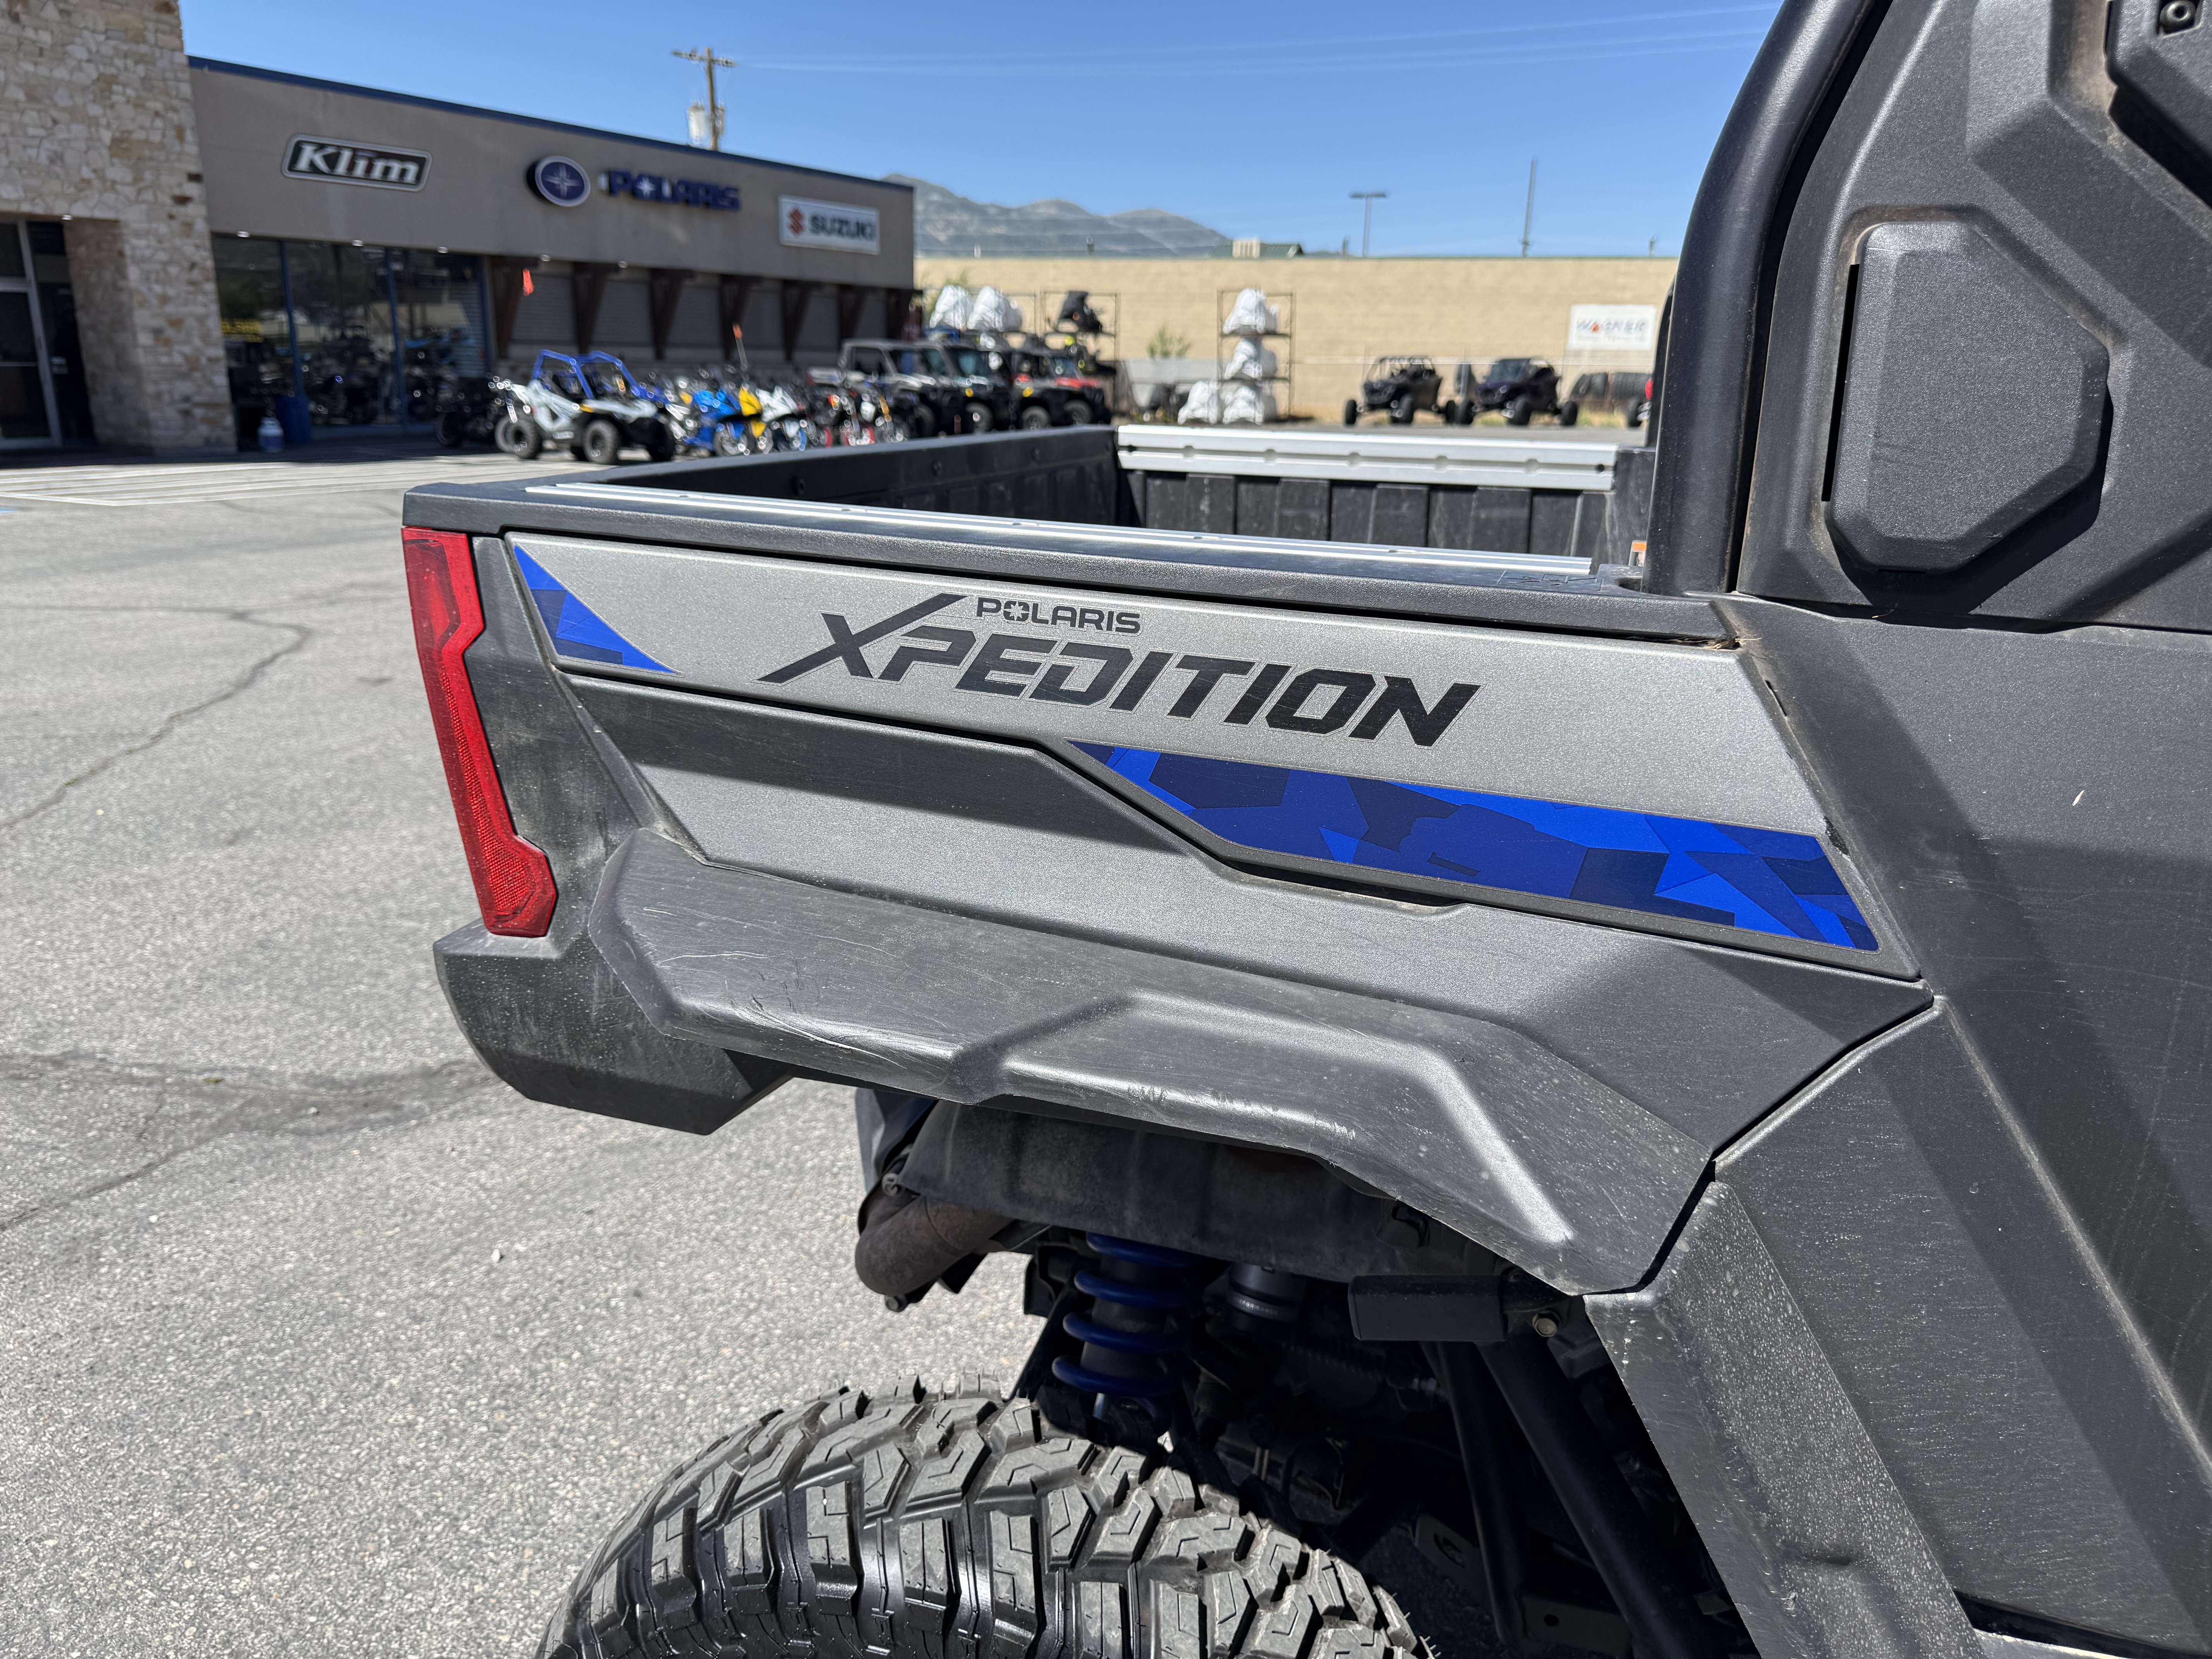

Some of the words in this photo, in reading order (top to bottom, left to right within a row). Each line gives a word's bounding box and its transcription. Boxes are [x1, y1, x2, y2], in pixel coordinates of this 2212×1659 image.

[609, 170, 741, 212] POLARIS
[809, 215, 877, 242] SUZUKI
[976, 597, 1140, 634] POLARIS
[755, 593, 1481, 747] XPEDITION
